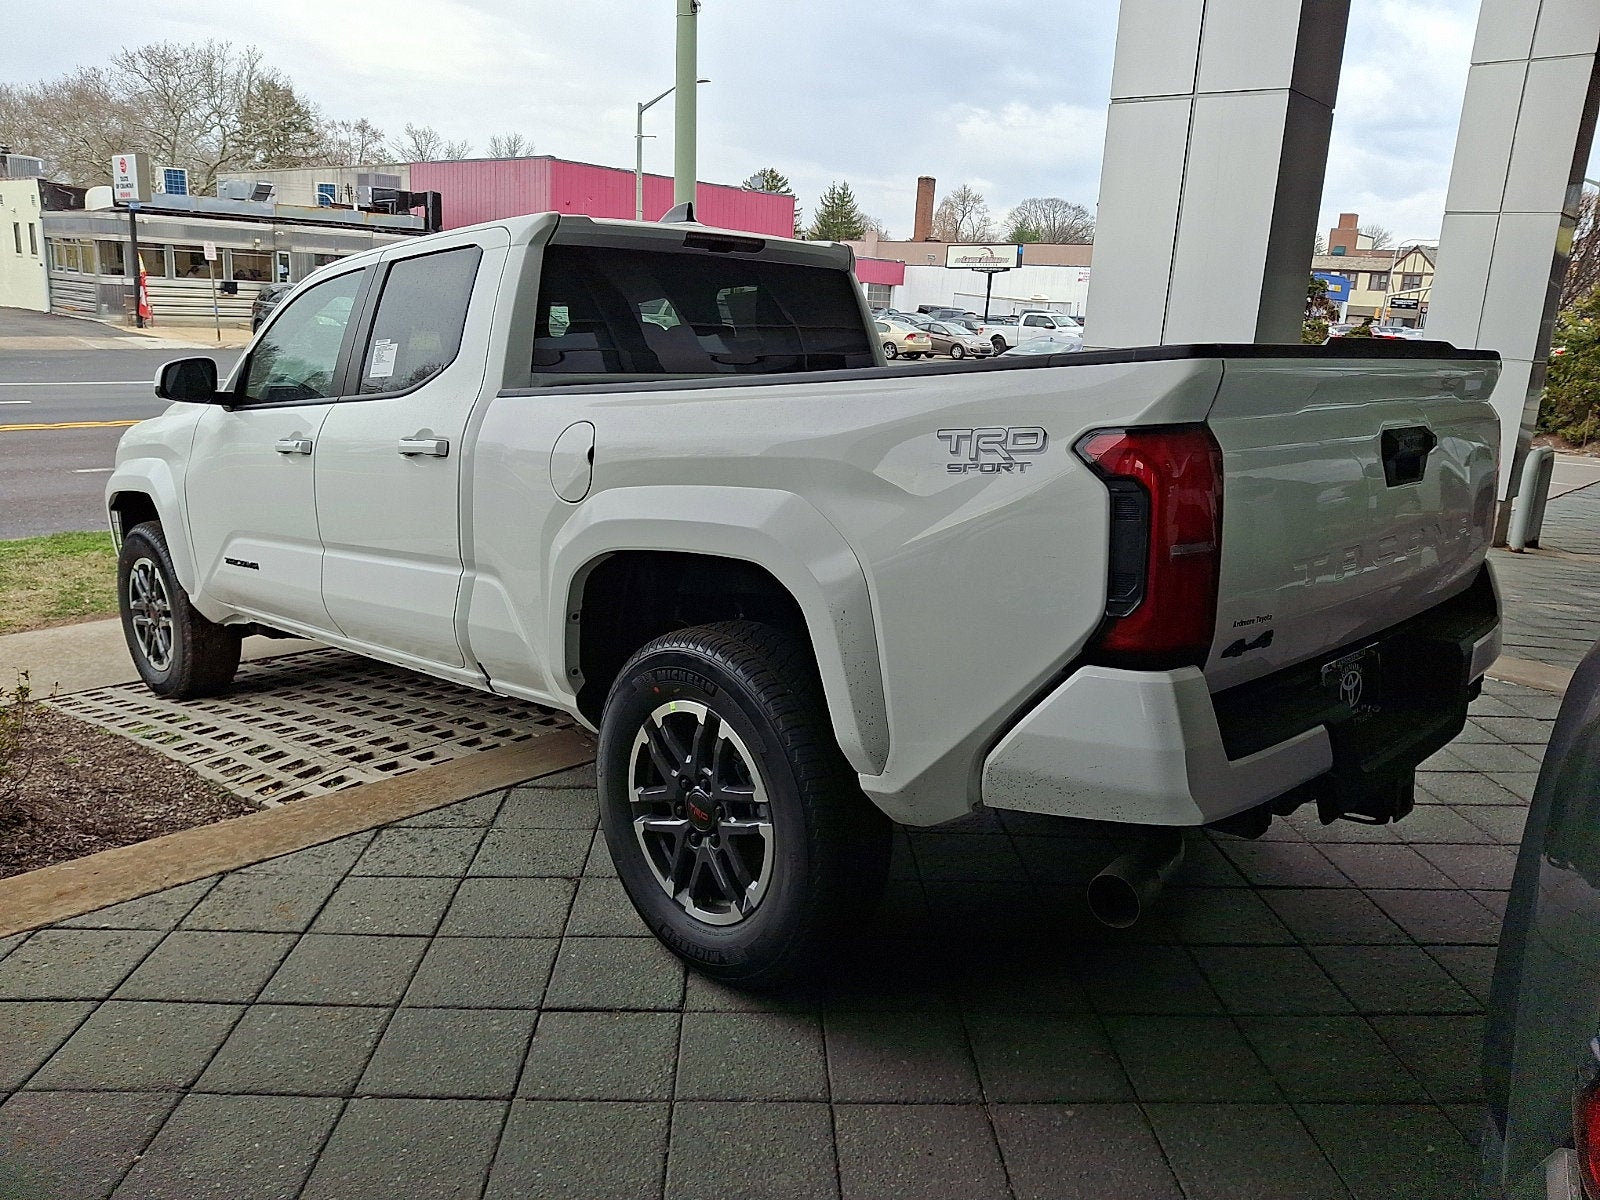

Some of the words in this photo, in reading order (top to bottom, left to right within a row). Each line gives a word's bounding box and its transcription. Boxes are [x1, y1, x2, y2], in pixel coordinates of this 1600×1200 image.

[937, 426, 1049, 461] TRD
[946, 461, 1033, 475] SPORT
[1232, 618, 1256, 629] Ardmore
[1255, 613, 1273, 624] Toyota
[656, 669, 718, 697] MICHELIN
[689, 802, 709, 821] TRD
